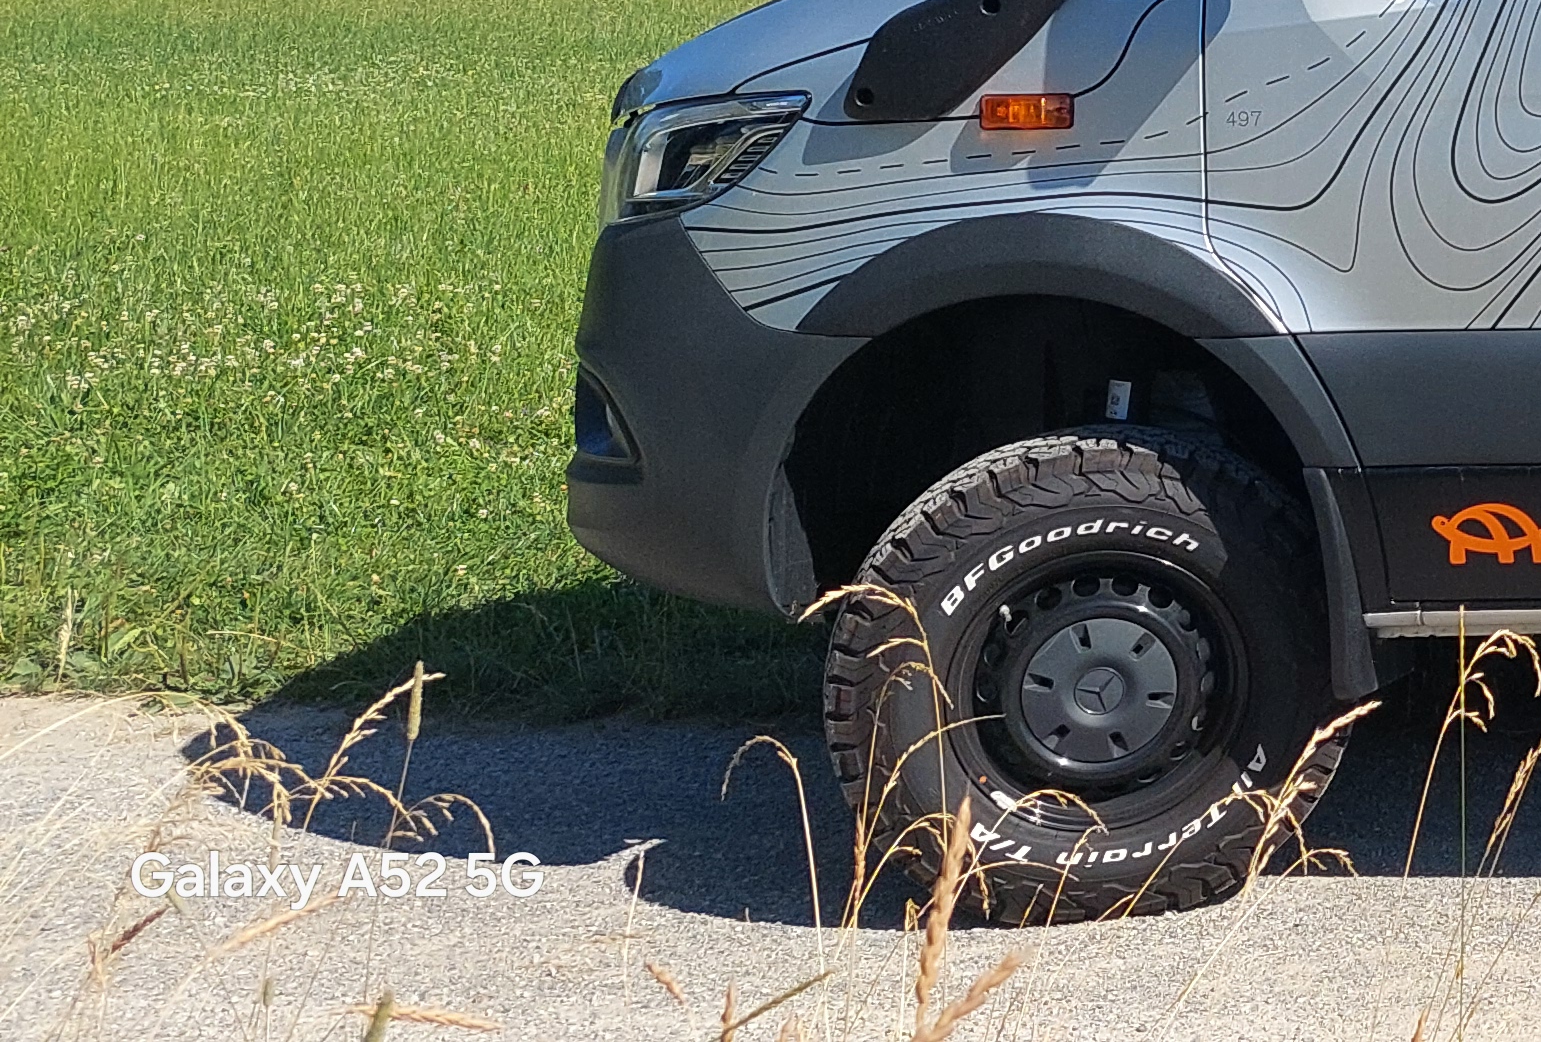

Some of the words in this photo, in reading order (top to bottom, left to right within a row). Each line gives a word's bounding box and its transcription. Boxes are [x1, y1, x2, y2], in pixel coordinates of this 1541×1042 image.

[1226, 110, 1262, 127] 497
[940, 518, 1201, 617] BFGoodrich
[969, 821, 1033, 863] T/A
